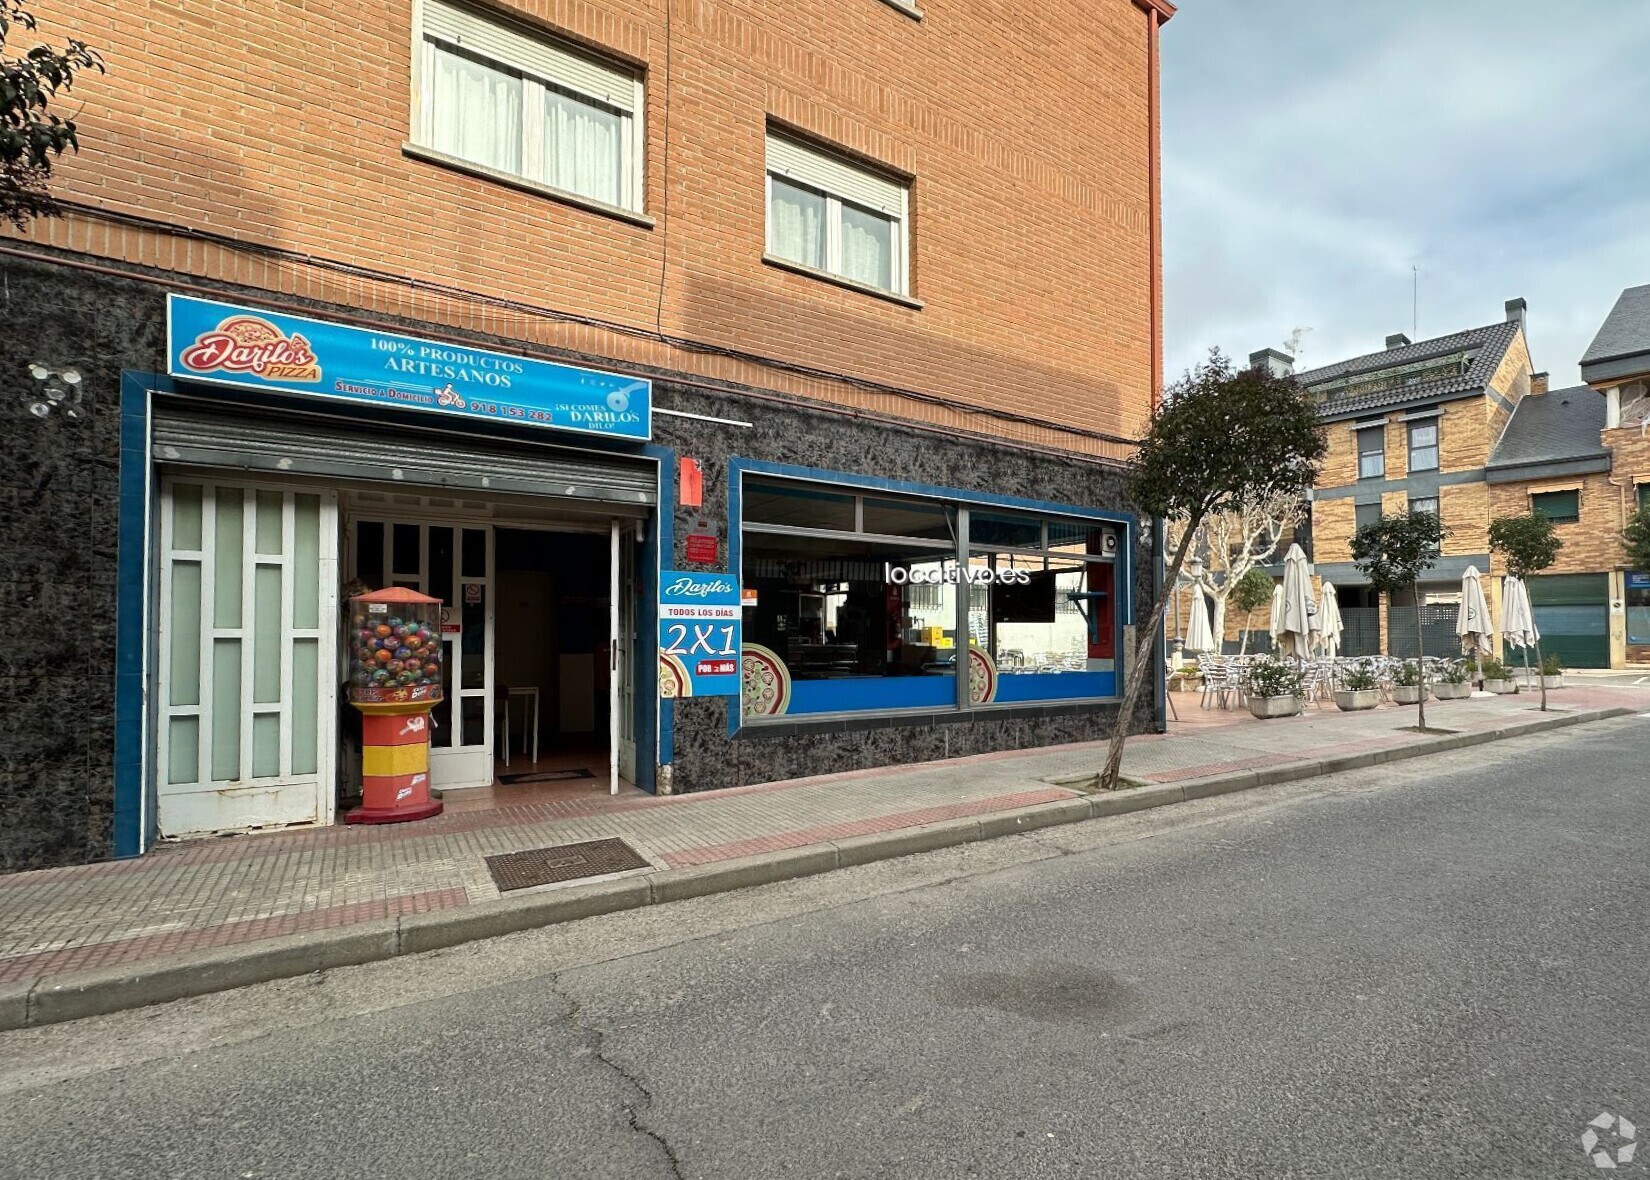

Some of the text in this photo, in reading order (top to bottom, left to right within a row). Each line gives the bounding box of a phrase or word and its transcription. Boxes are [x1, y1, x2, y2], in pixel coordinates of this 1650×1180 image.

[370, 337, 524, 374] 100% PRODUCTOS
[267, 365, 317, 379] PIZZA
[384, 356, 512, 388] ARTESANOS
[470, 402, 553, 422] 918 153 282
[570, 404, 607, 412] COMES
[668, 608, 734, 617] TODOS LOS DÍAS
[665, 623, 737, 656] 2X1
